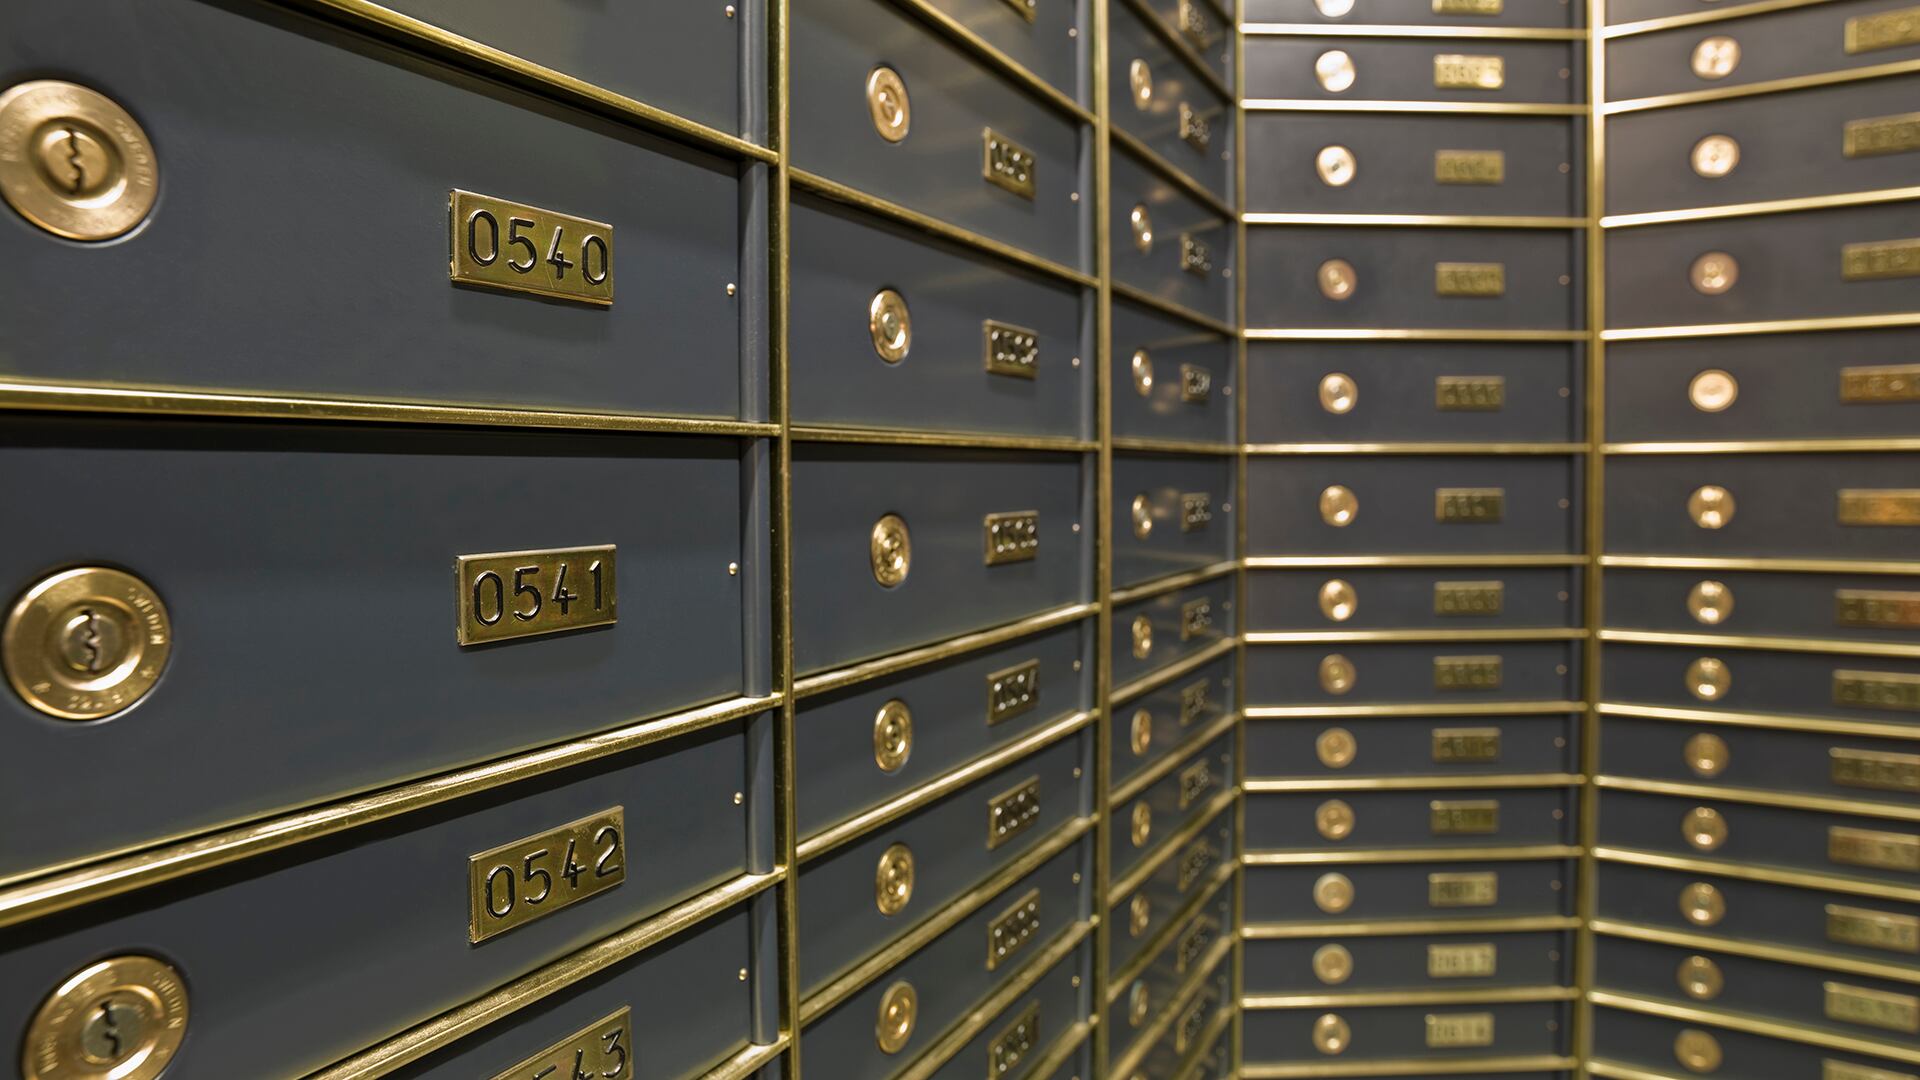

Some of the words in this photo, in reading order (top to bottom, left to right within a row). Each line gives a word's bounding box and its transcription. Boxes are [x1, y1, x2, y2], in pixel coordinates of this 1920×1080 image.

[468, 208, 609, 287] 0540
[473, 559, 602, 627] 0541
[485, 825, 621, 919] 0542
[532, 1026, 626, 1080] 43
